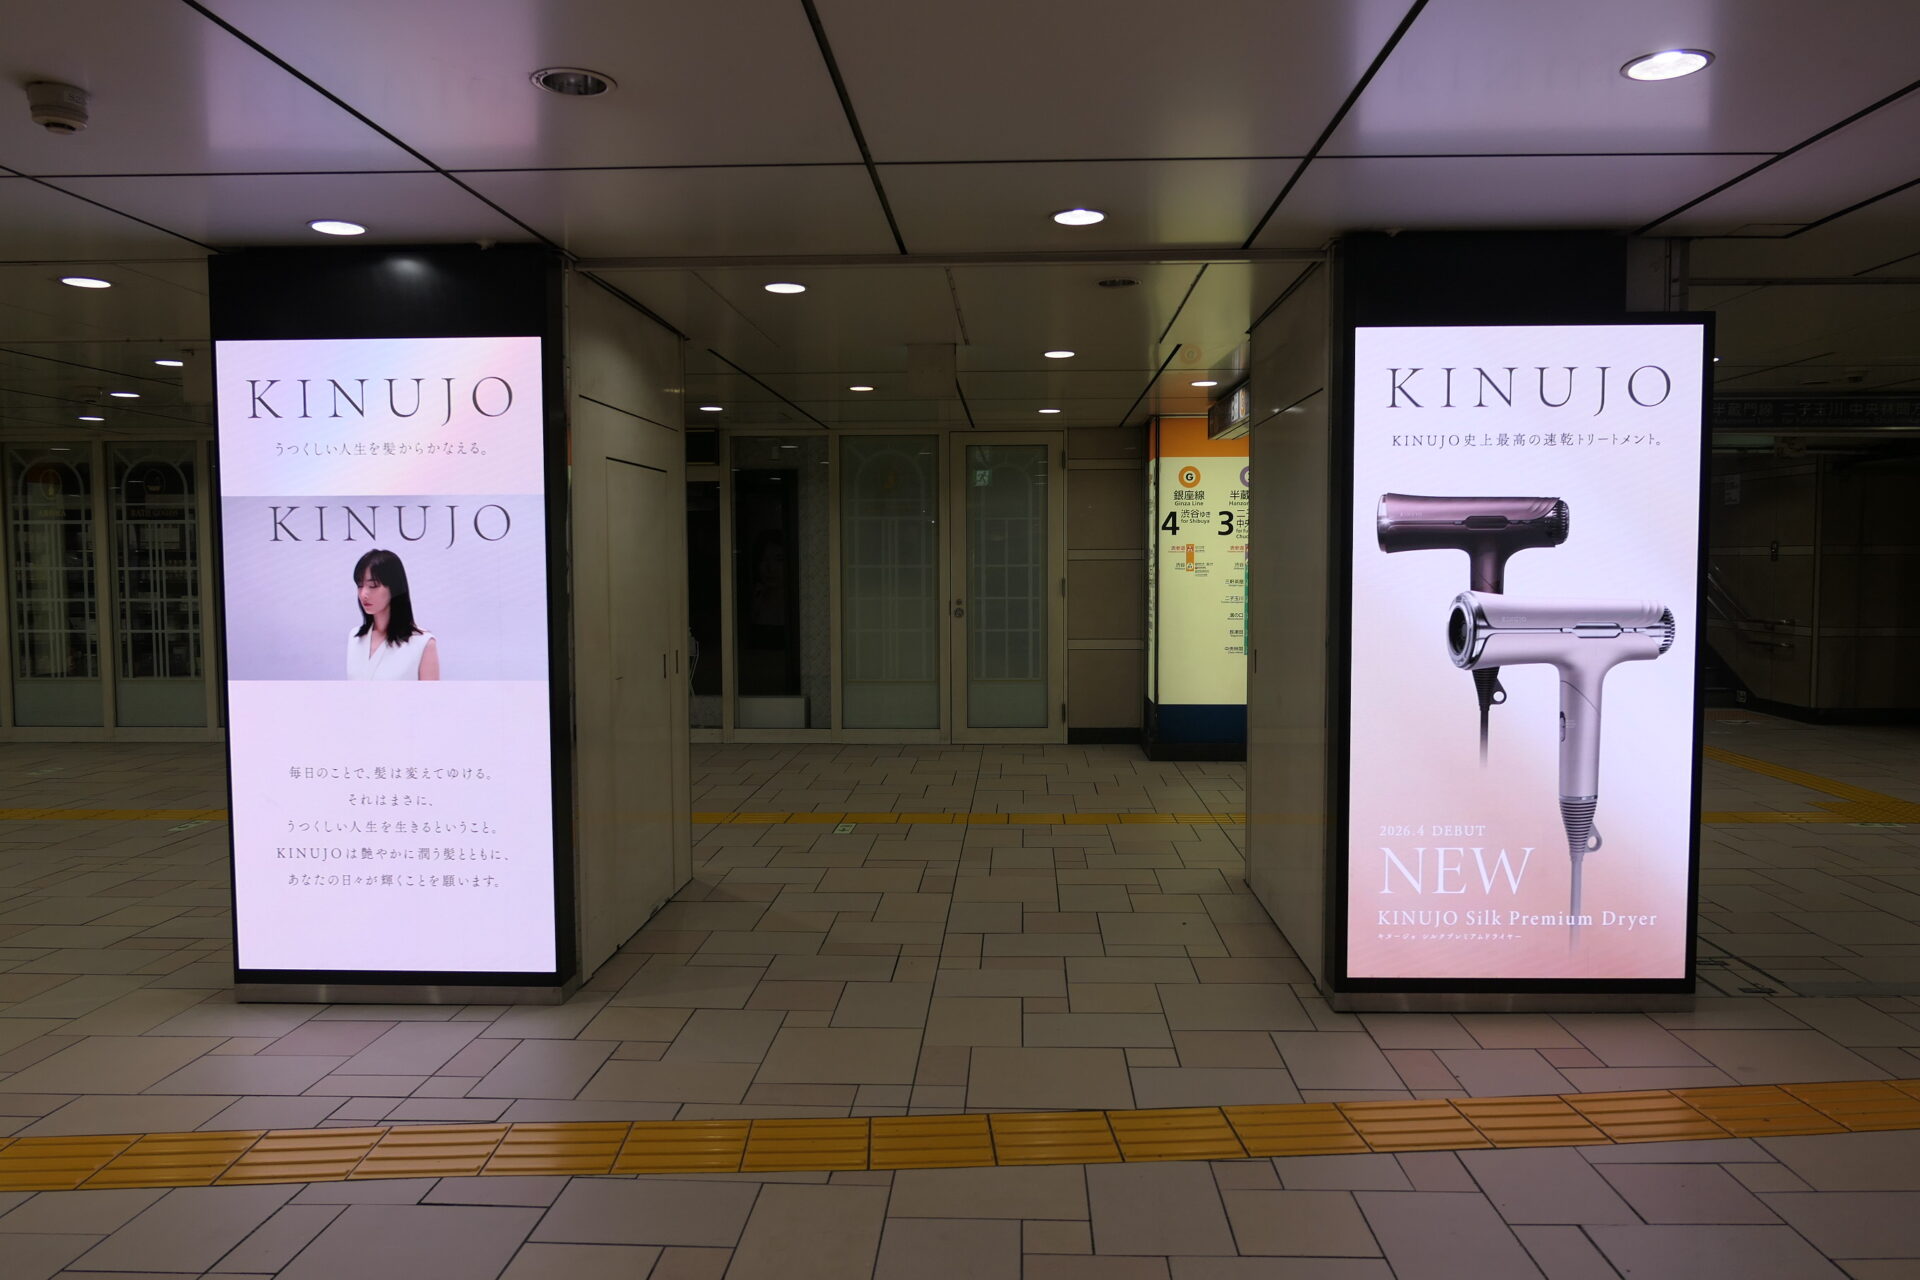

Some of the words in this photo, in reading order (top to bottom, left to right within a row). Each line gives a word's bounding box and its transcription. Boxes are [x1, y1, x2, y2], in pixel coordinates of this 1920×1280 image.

[1386, 364, 1672, 417] KINUJO
[246, 376, 513, 427] KINUJO
[1392, 432, 1661, 449] KINUJO史上最高の速乾トリートメント。
[275, 441, 487, 457] うつくしい人生を髪からかなえる。
[1185, 473, 1194, 481] G
[1173, 490, 1205, 500] 銀座線
[1180, 509, 1211, 519] 渋谷ゆき
[1236, 509, 1249, 518] 二
[268, 504, 511, 550] KINUJO
[1161, 511, 1180, 536] 4
[1217, 511, 1234, 536] 3
[289, 765, 491, 781] 毎日のことで、髪は変えてゆける。
[348, 793, 433, 807] それはまさに、
[287, 819, 497, 835] うつくしい人生を生きるということ。
[1379, 825, 1425, 837] 2026.4
[1432, 825, 1486, 837] DEBUT
[276, 847, 510, 862] KINUJOは艶やかに潤う髪とともに、
[1379, 847, 1535, 895] NEW
[288, 873, 500, 888] あなたの日々が輝くことを願います。
[1378, 910, 1458, 928] KINUJO
[1466, 909, 1502, 926] Silk
[1509, 910, 1593, 926] Premium
[1602, 910, 1657, 931] Dryer
